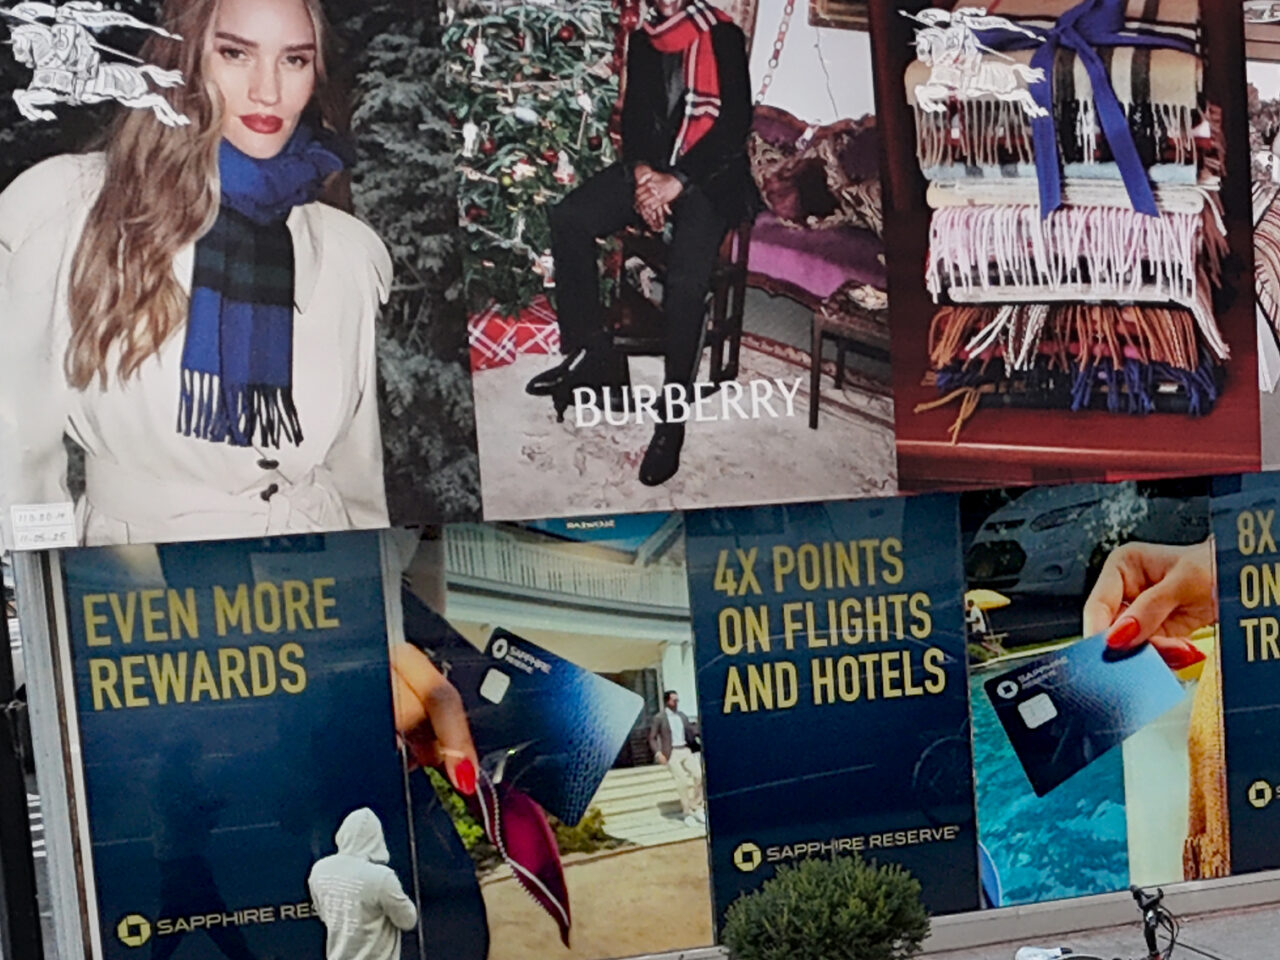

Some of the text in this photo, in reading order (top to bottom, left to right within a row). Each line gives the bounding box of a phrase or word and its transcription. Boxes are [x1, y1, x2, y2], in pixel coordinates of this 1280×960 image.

[573, 378, 803, 427] BURBERRY
[1236, 509, 1278, 556] 8X
[713, 537, 904, 597] 4X POINTS
[84, 577, 340, 647] EVEN MORE
[718, 592, 932, 656] ON FLIGHTS
[88, 643, 307, 711] REWARDS
[723, 647, 946, 715] AND HOTELS
[767, 836, 865, 862] SAPPHIRE
[156, 907, 275, 935] SAPPHIRE
